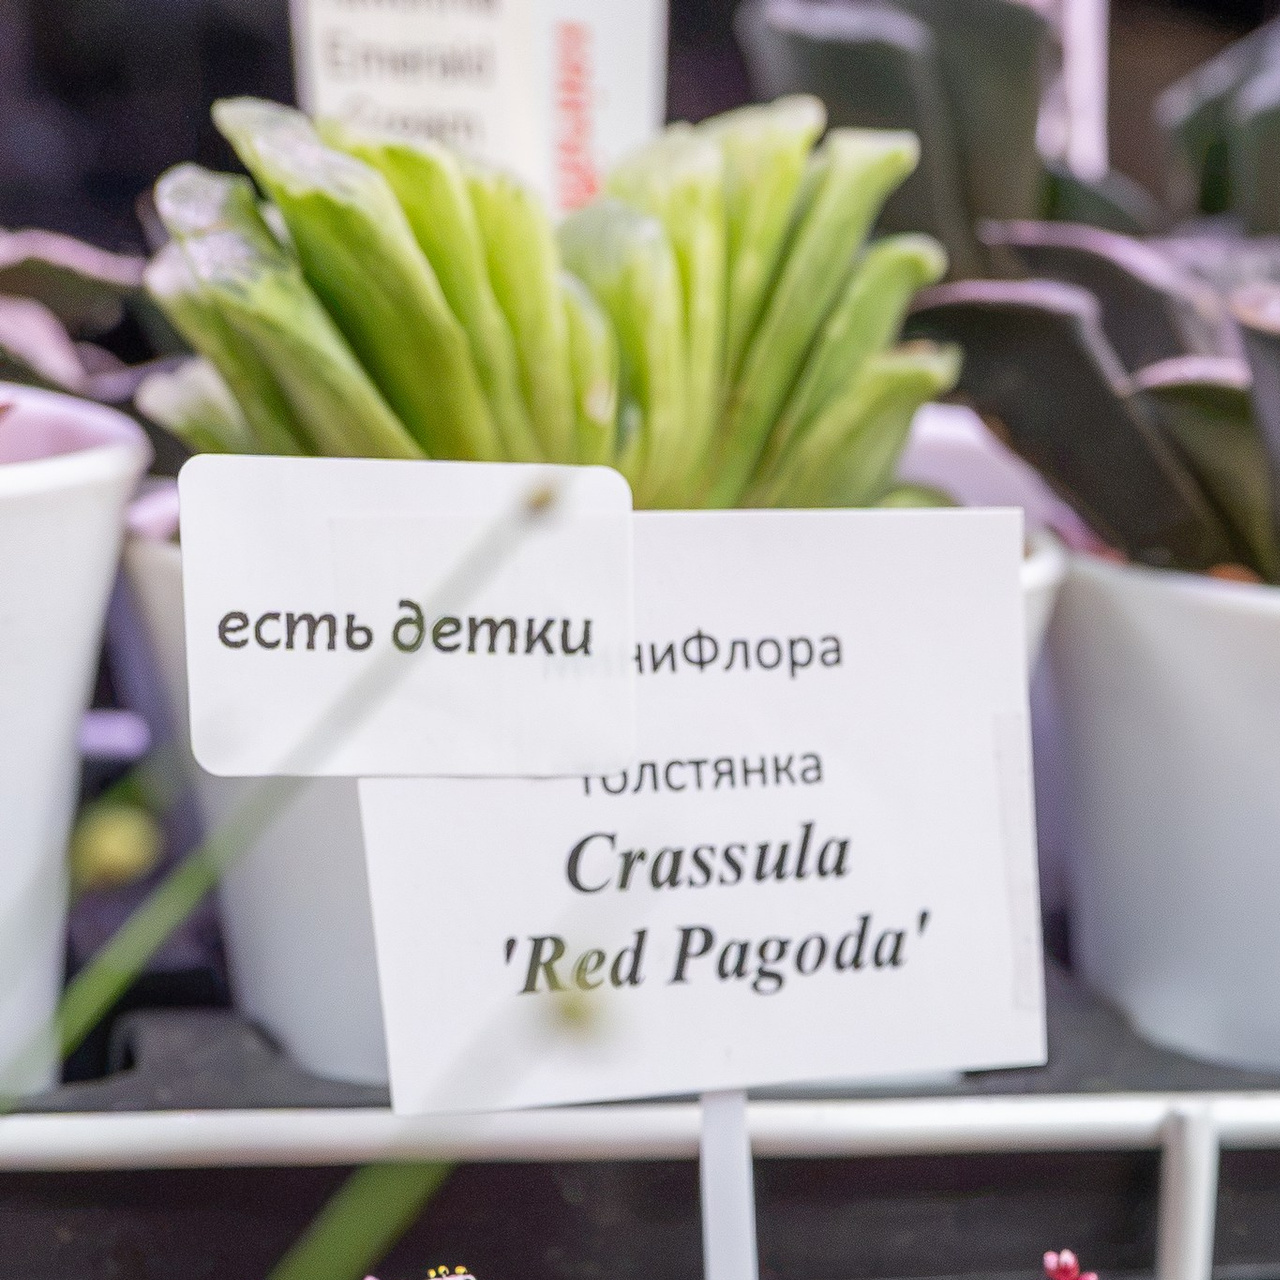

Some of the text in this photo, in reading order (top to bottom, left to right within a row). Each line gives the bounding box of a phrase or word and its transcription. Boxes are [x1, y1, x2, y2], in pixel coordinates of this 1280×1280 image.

[218, 599, 594, 658] есть детки
[565, 822, 852, 896] Crassula
[503, 910, 931, 996] 'Red Pagoda'
